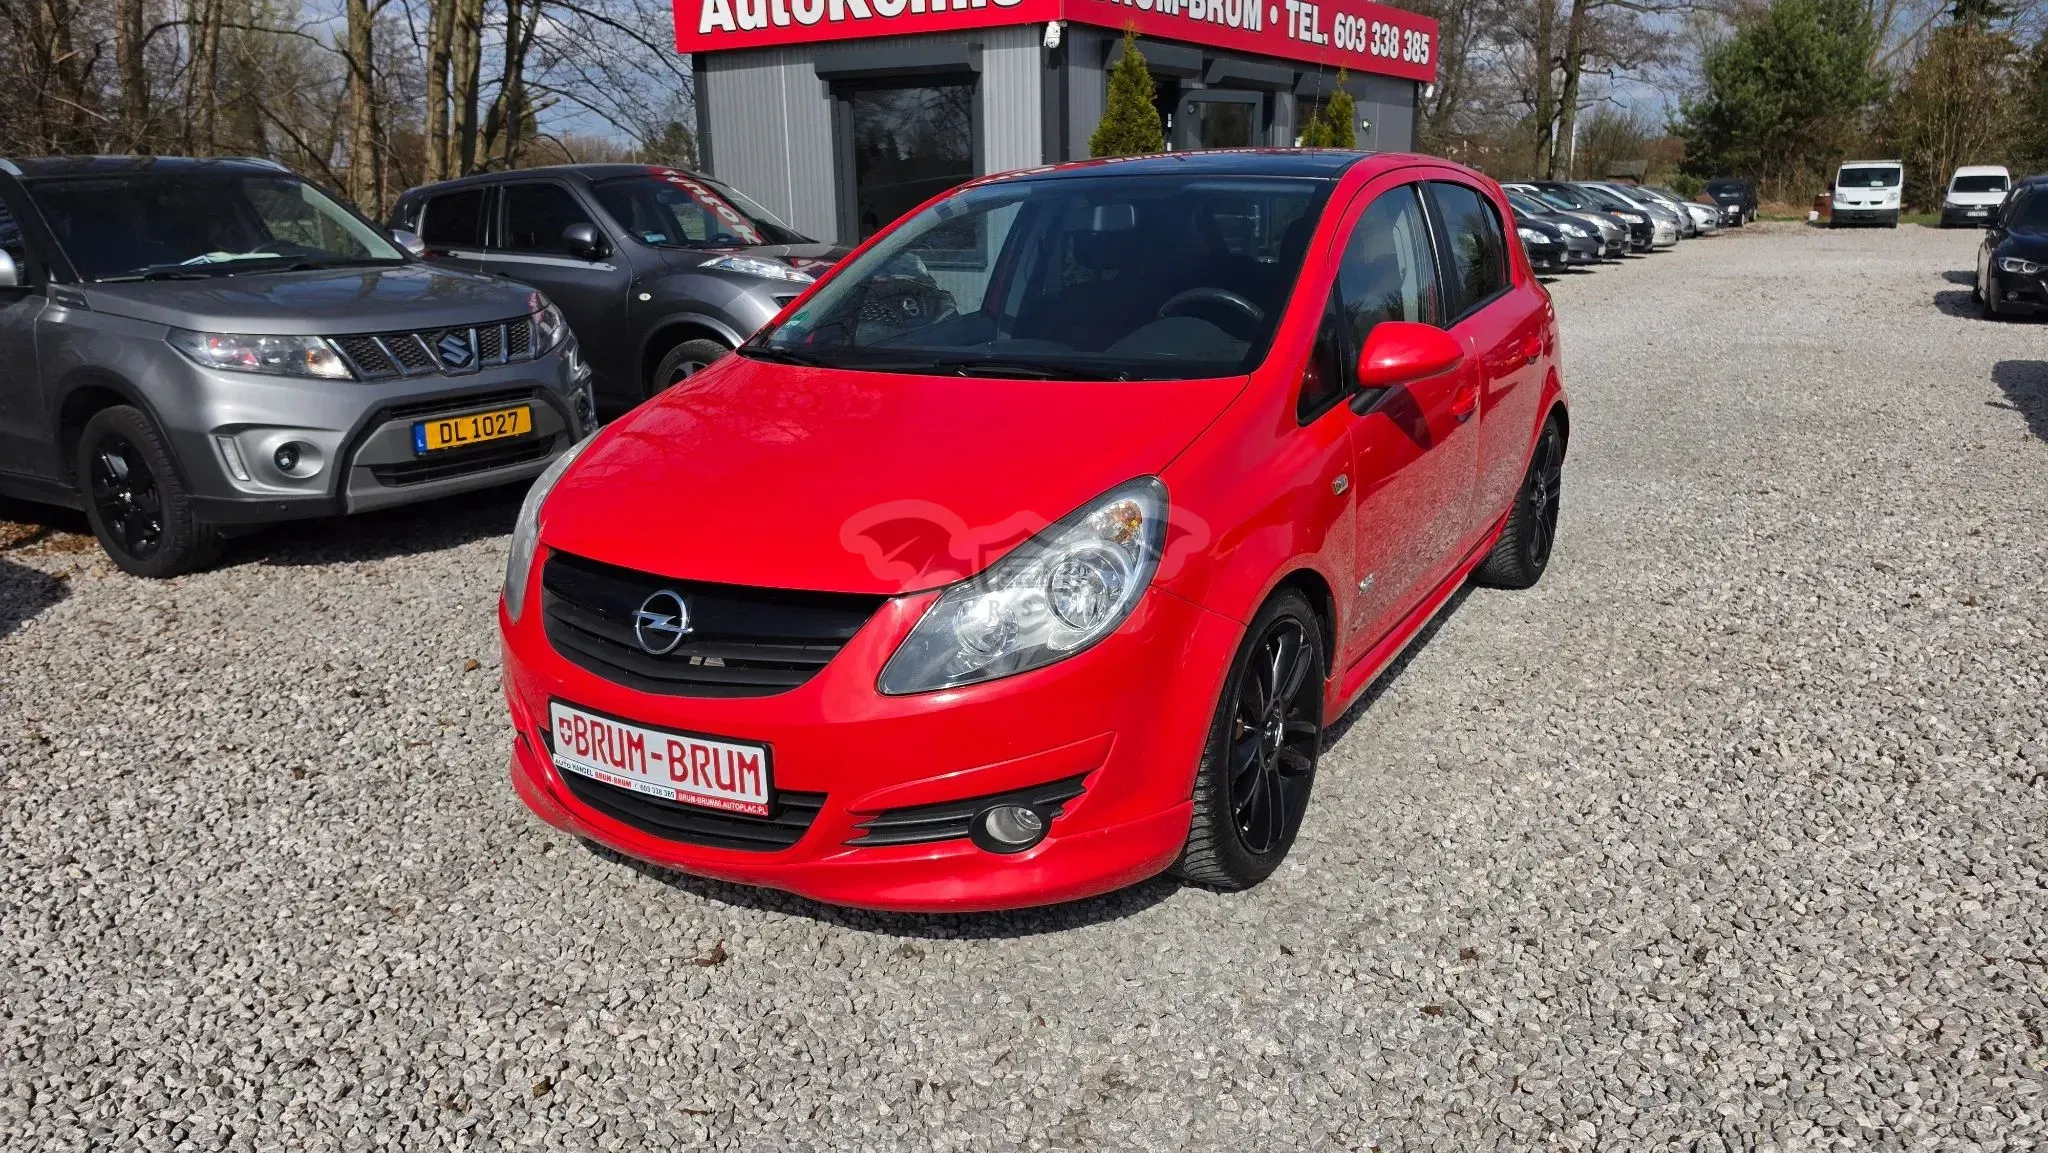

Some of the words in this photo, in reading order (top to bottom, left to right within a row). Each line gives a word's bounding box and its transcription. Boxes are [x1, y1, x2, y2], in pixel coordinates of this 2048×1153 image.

[1285, 0, 1328, 46] TEL.
[1334, 12, 1366, 53] 603
[1370, 21, 1400, 59] 338
[1403, 29, 1430, 65] 385
[440, 421, 467, 444] DL
[472, 411, 518, 438] 1027
[555, 758, 571, 769] AUTO
[594, 771, 632, 788] BRUM-BRUM
[572, 714, 762, 797] BRUM-BRUM
